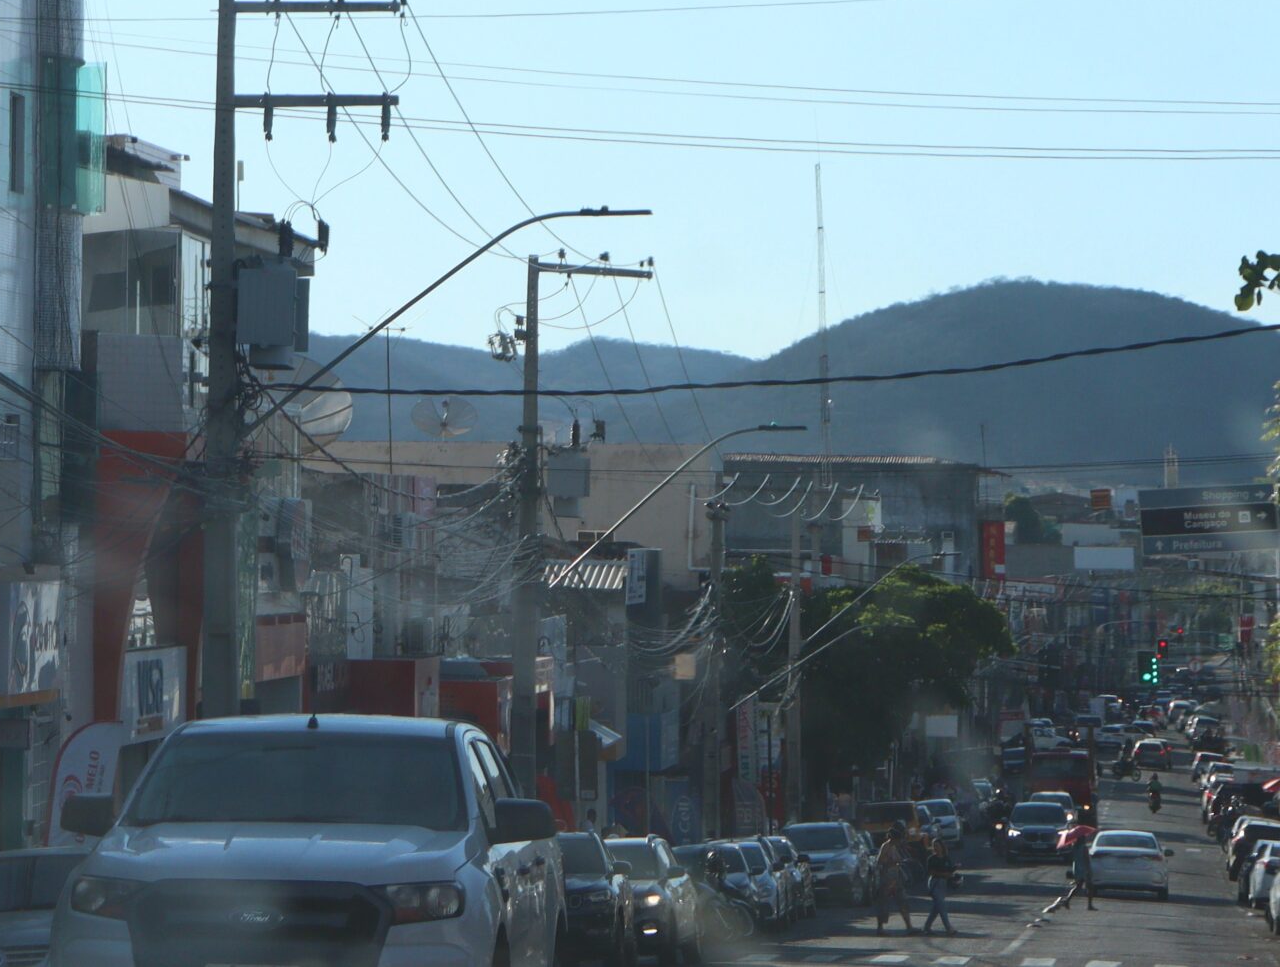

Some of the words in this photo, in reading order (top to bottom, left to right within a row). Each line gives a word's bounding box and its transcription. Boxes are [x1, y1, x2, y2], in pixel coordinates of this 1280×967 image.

[1201, 490, 1250, 501] Shopping
[1184, 511, 1216, 520] Museu
[1184, 520, 1228, 529] Cangaço
[1172, 540, 1224, 551] Prefeitura
